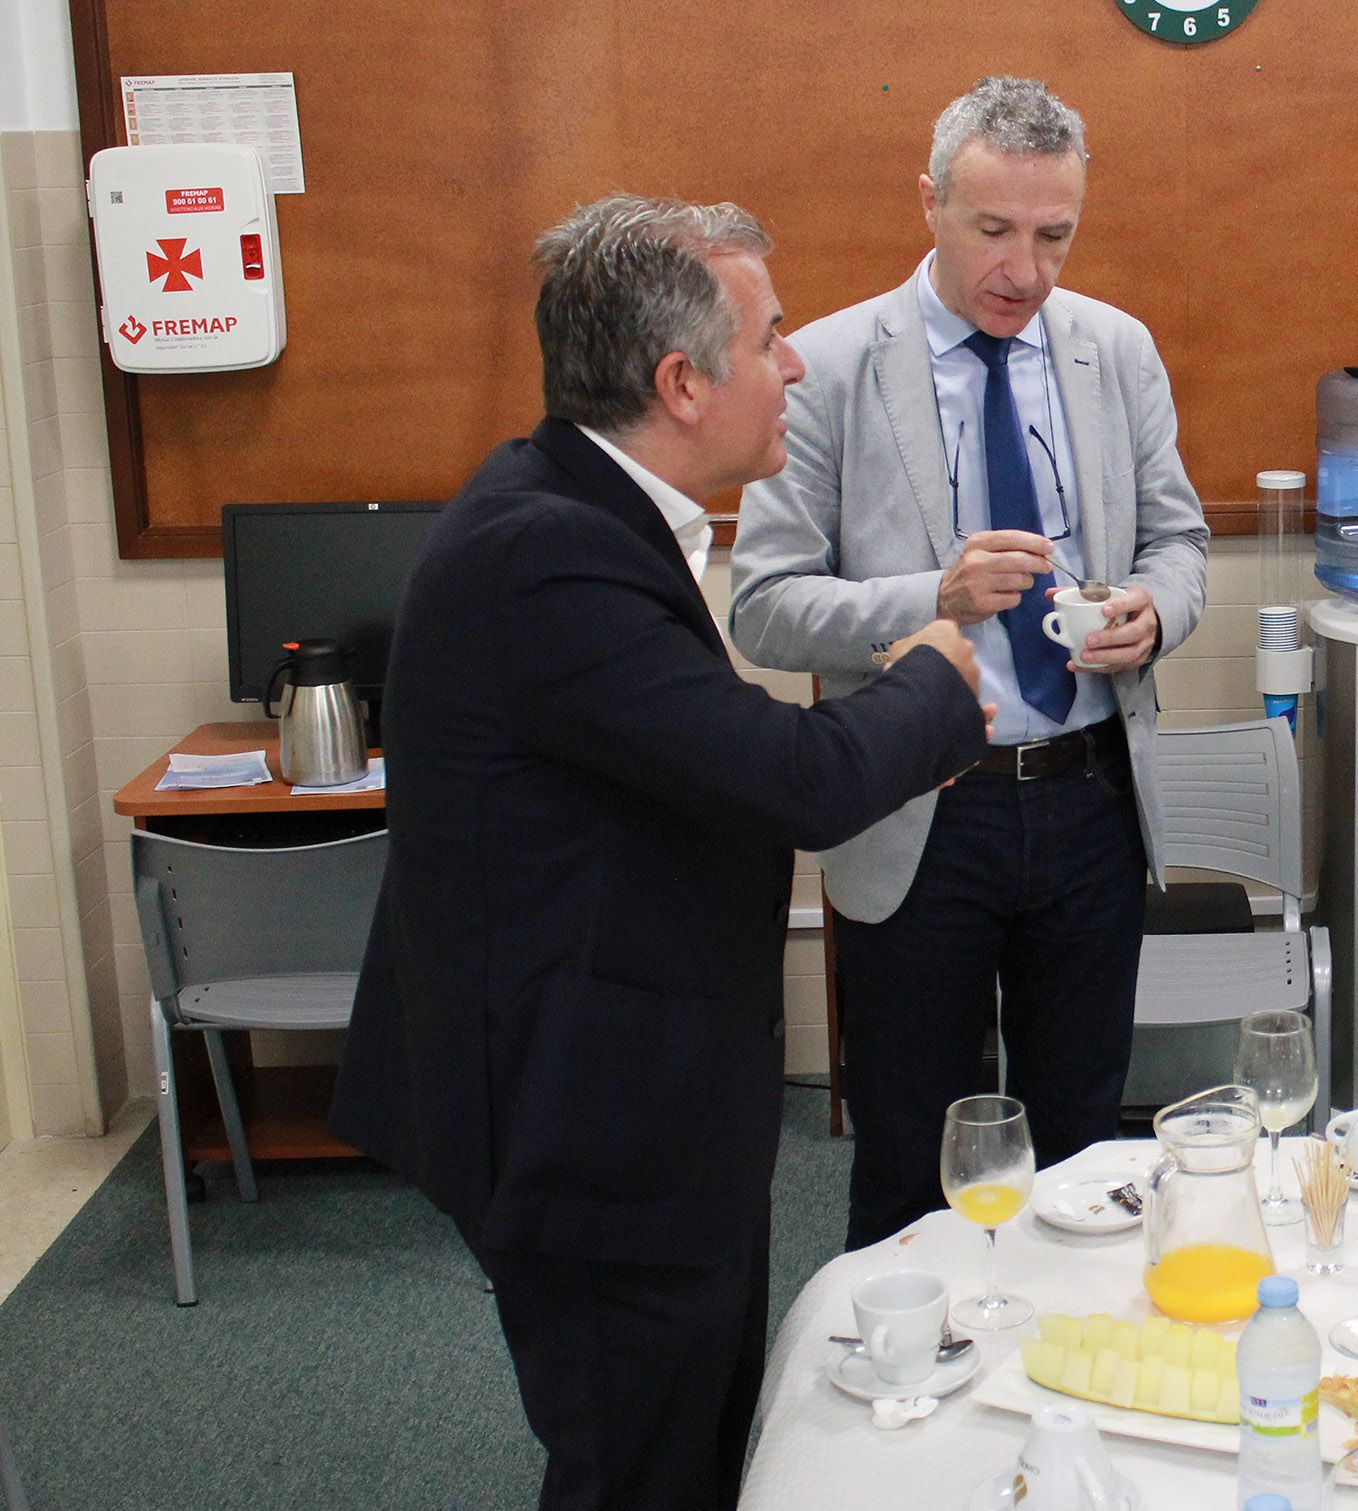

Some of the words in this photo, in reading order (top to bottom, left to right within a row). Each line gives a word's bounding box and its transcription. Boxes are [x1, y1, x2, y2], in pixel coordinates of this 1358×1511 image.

[1148, 12, 1161, 32] 7
[1183, 17, 1197, 36] 6
[1217, 8, 1231, 27] 5
[152, 317, 238, 336] FREMAP
